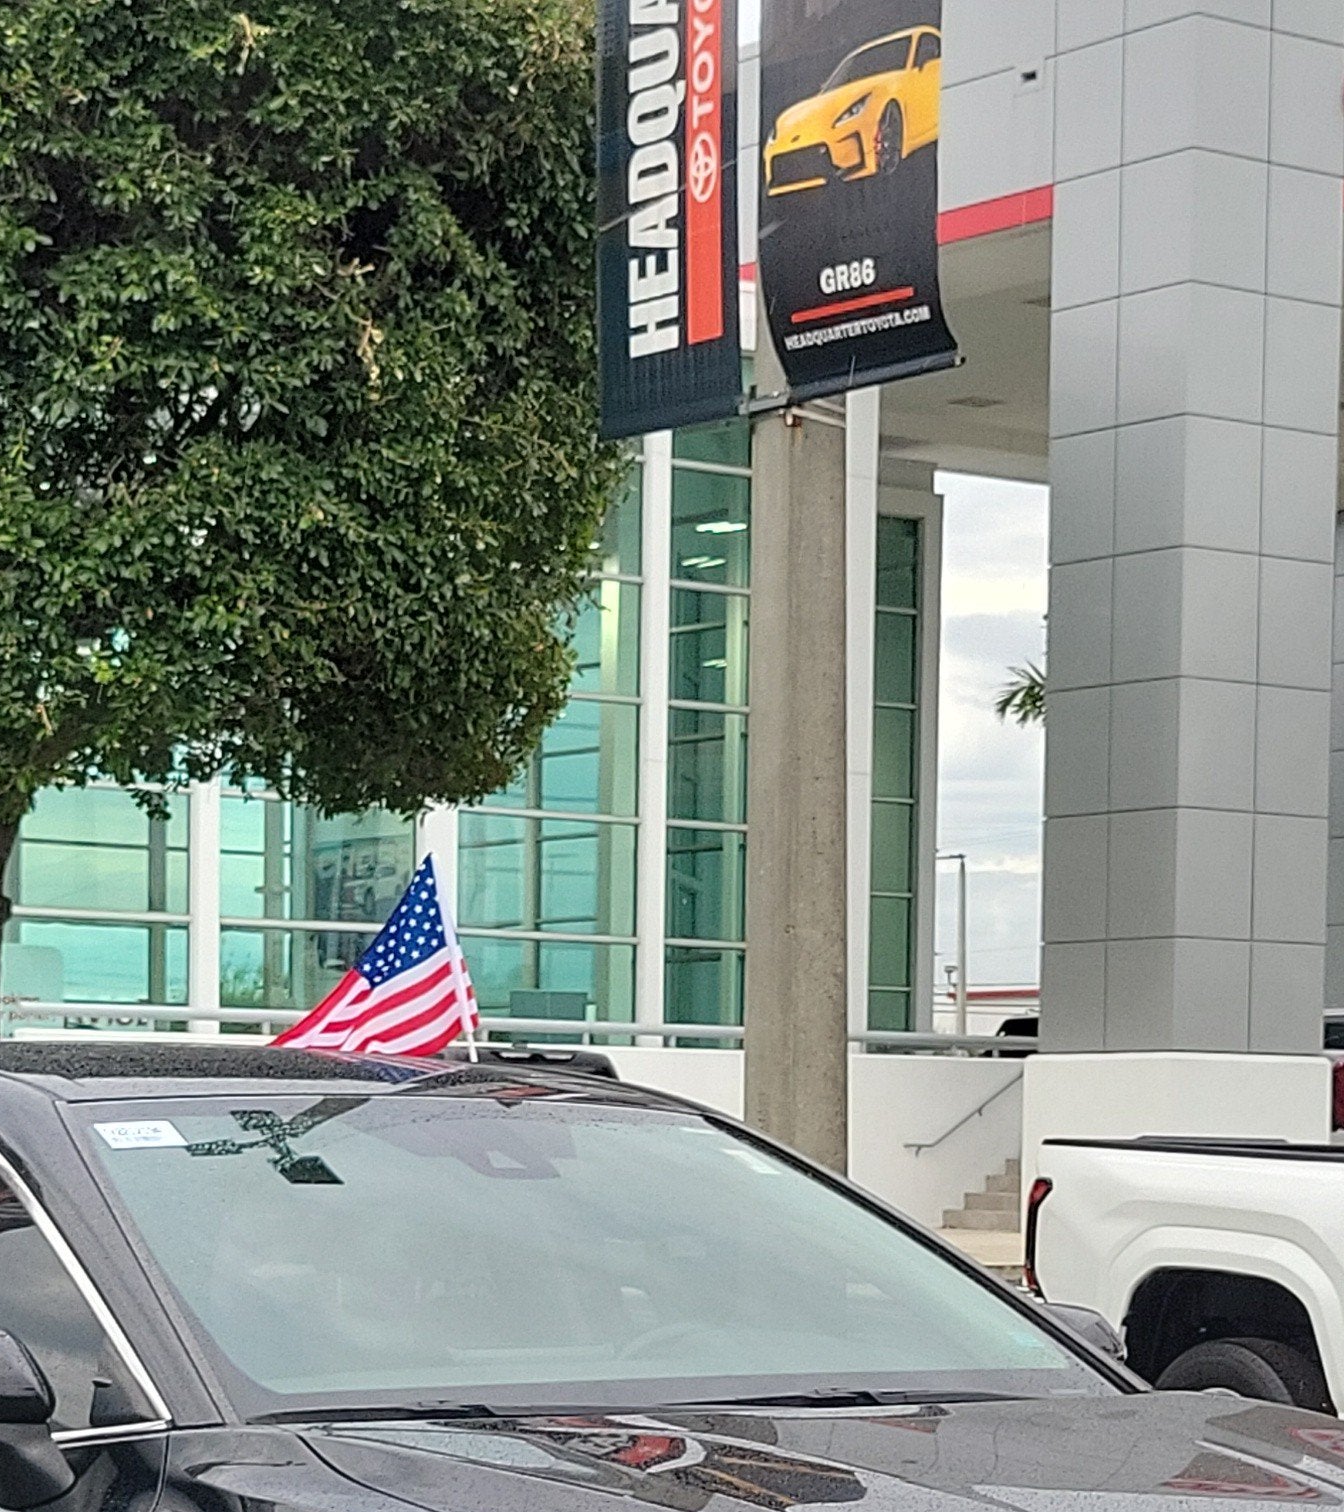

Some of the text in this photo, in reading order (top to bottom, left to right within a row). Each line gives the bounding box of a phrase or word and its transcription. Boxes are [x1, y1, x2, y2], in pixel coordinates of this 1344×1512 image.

[692, 0, 715, 129] TOY
[819, 258, 876, 294] GR86
[784, 305, 931, 351] HEADQUARTERTOYOTA.COM
